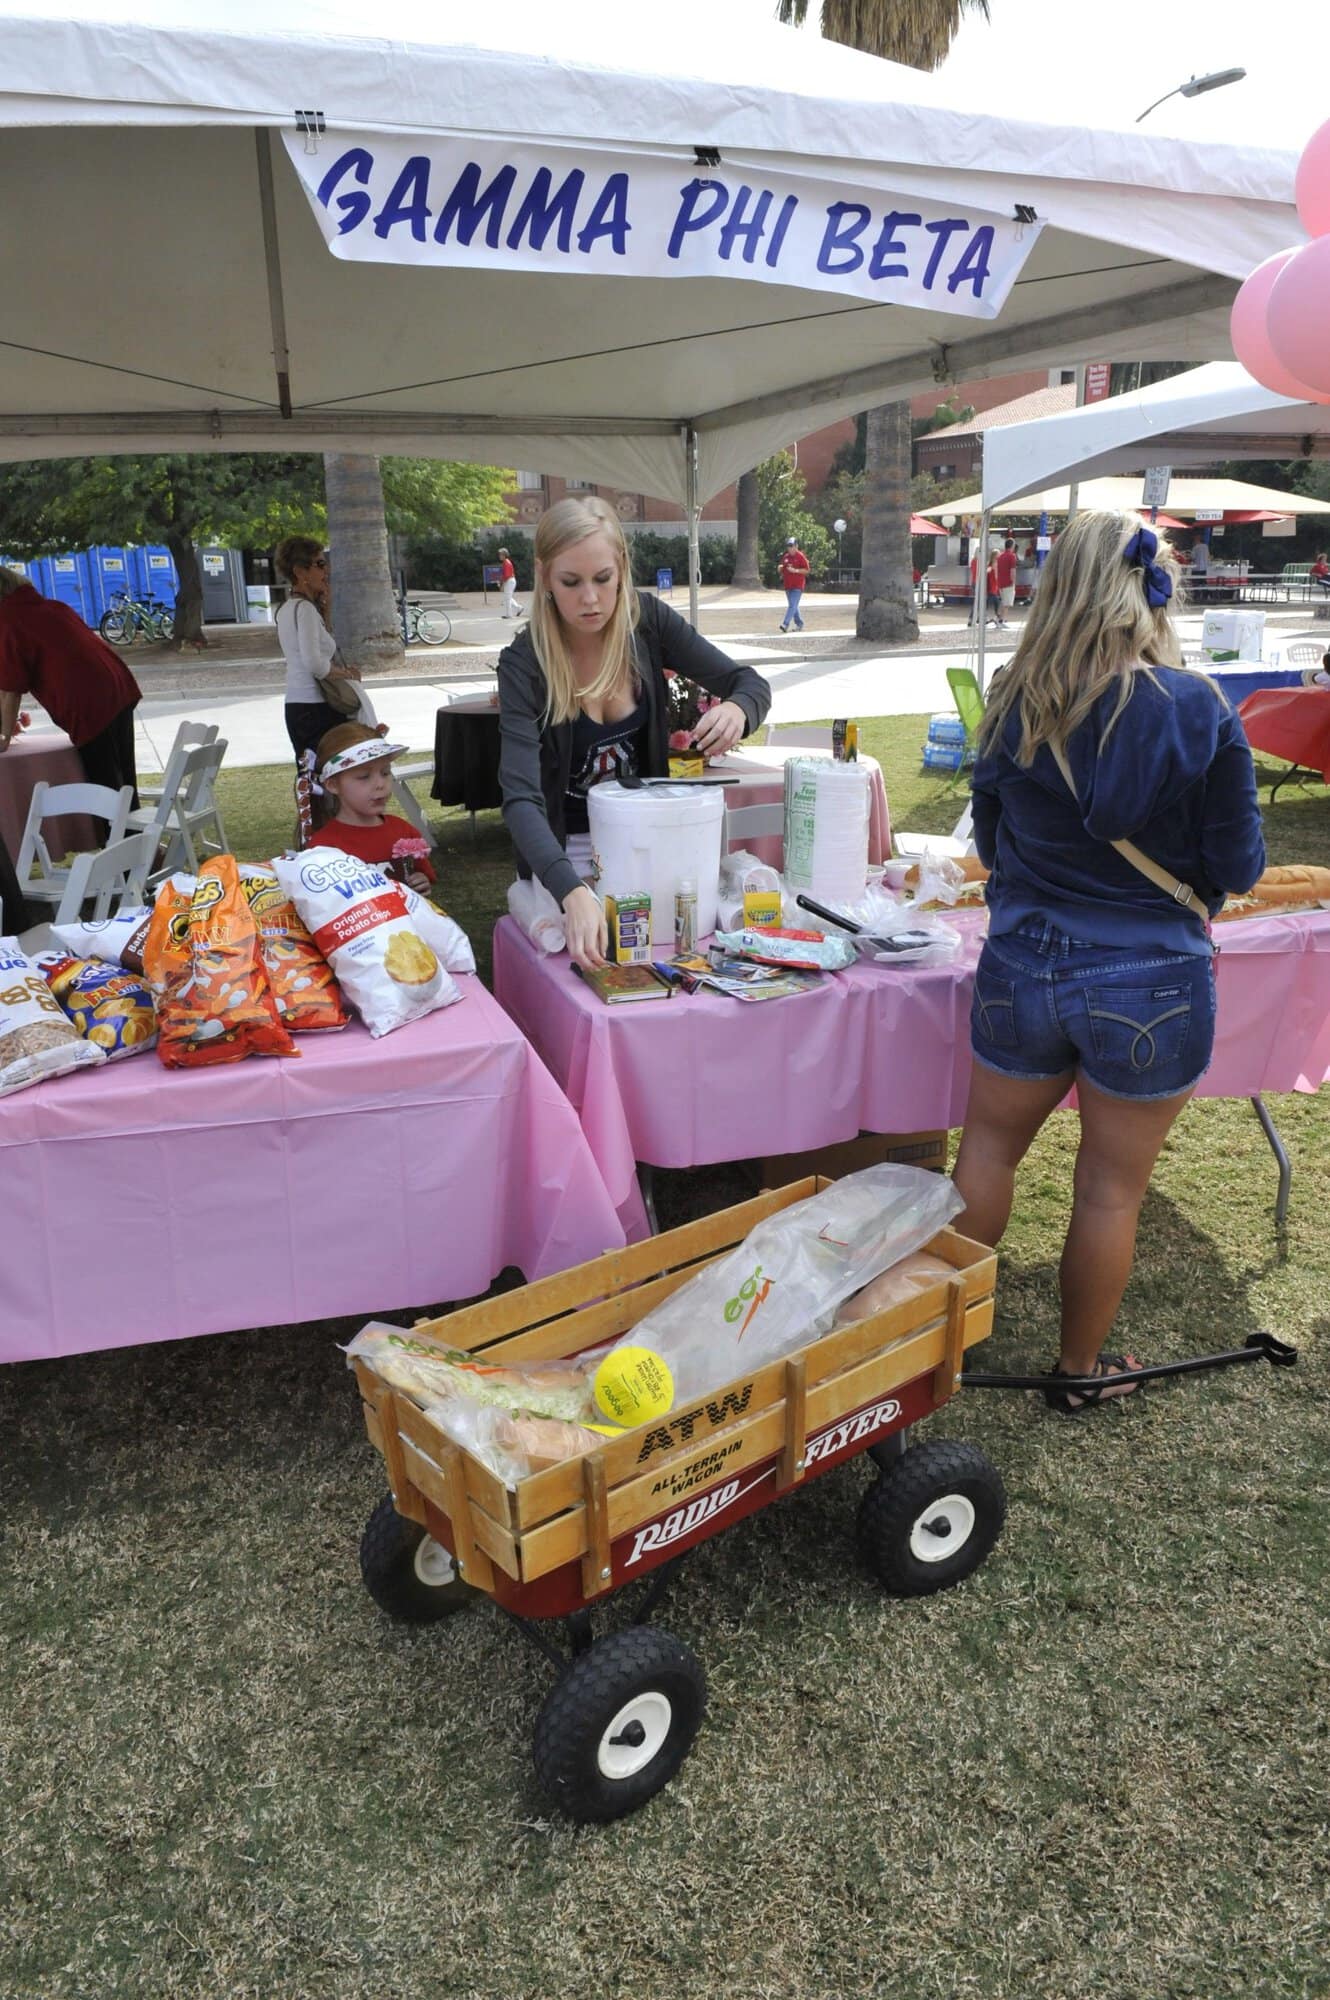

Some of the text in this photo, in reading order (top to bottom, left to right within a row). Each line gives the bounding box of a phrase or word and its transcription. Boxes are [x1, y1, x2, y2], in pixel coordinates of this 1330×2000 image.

[316, 147, 995, 299] GAMMA PHI BETA
[334, 872, 387, 899] Value
[333, 903, 370, 930] Original
[337, 909, 391, 940] Potato Chips
[636, 1383, 754, 1464] ATW
[624, 1399, 898, 1567] RADIO FLYER
[651, 1440, 743, 1496] ALL-TERRAIN
[671, 1461, 724, 1496] WAGON
